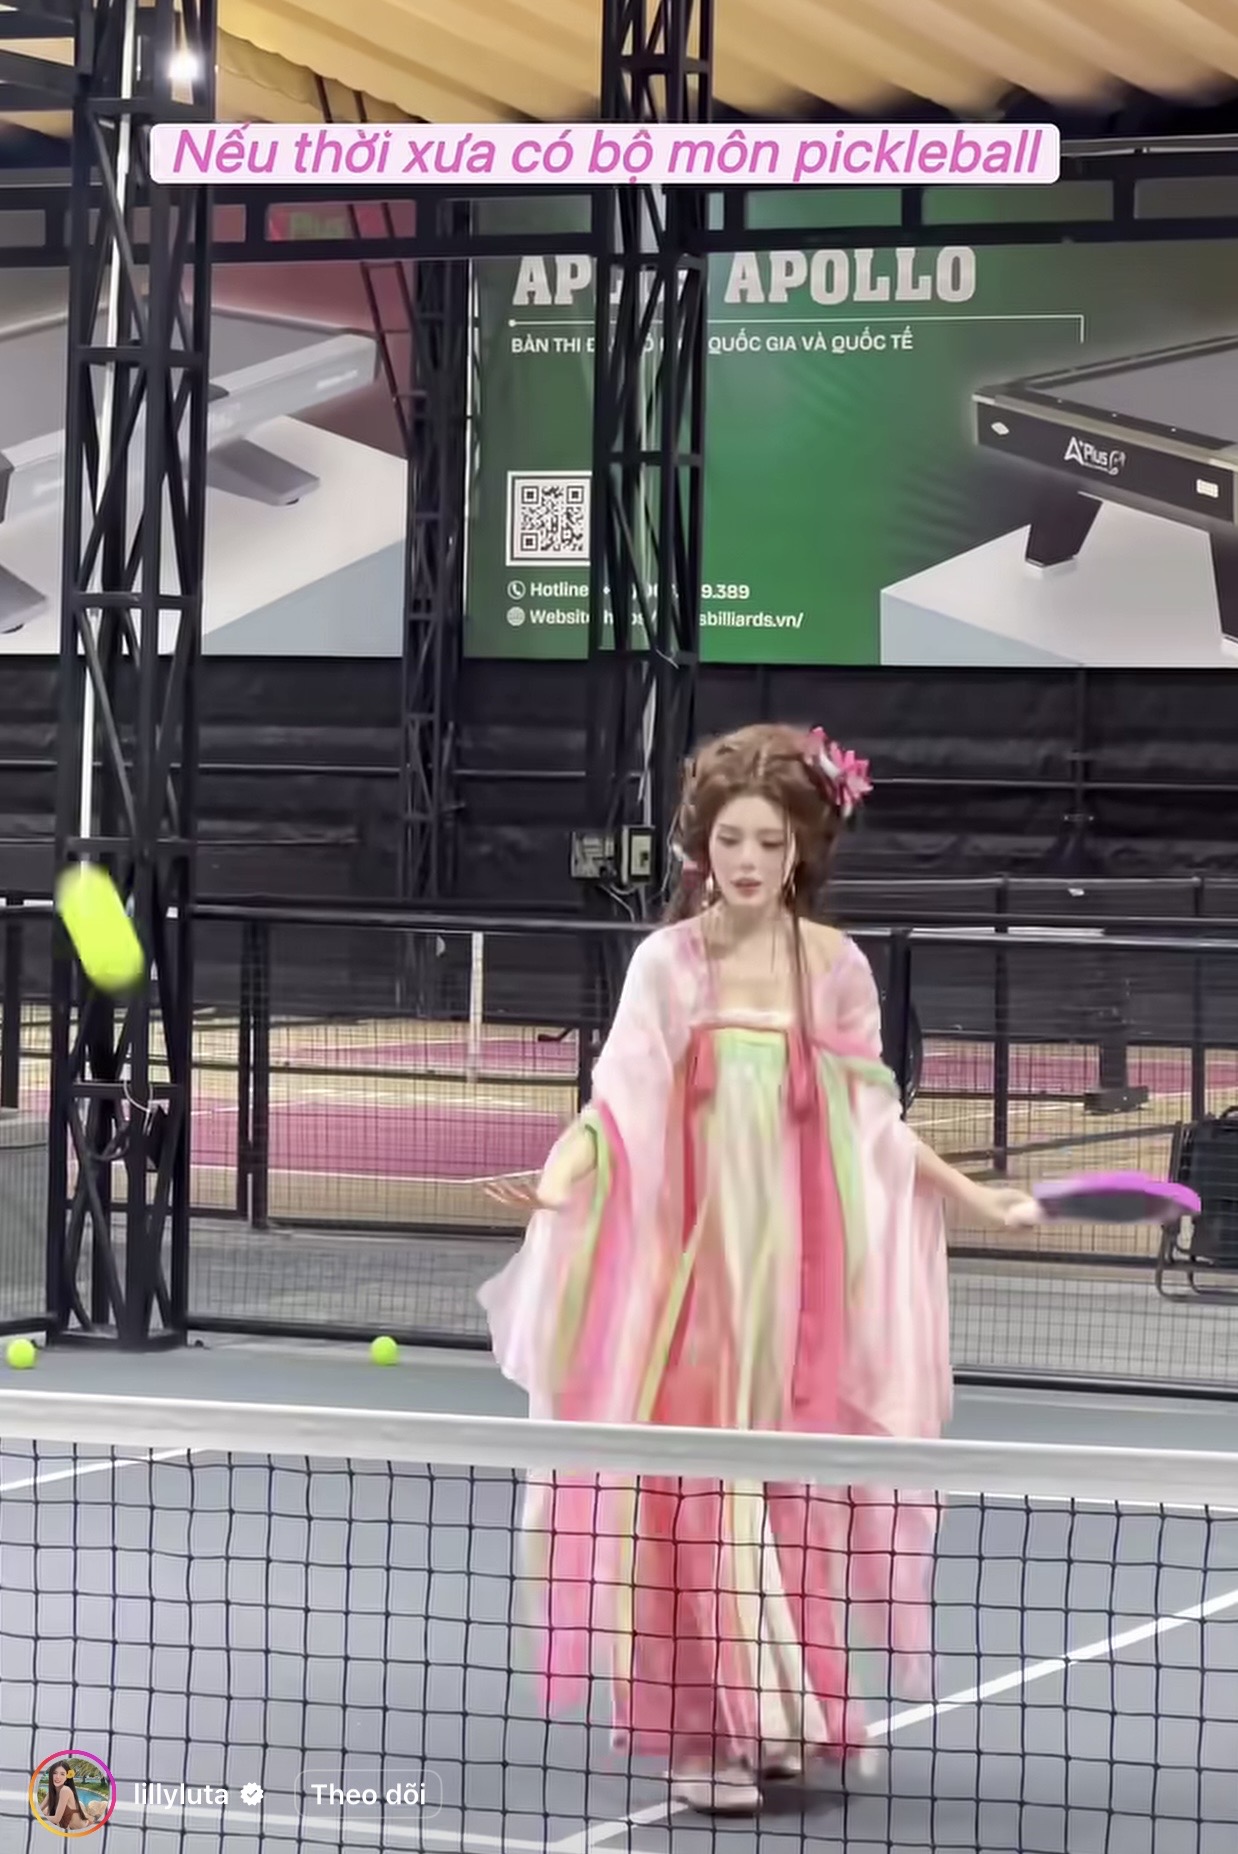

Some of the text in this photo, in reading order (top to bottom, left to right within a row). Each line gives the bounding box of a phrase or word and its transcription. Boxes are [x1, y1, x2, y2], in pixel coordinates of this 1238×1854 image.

[723, 246, 976, 305] APOLLO
[511, 333, 549, 353] BÀN
[554, 337, 582, 353] THI
[708, 328, 761, 354] QUỐC
[766, 336, 797, 351] GIA
[802, 331, 827, 351] VÀ
[832, 326, 886, 353] QUỐC
[890, 325, 914, 350] TẾ
